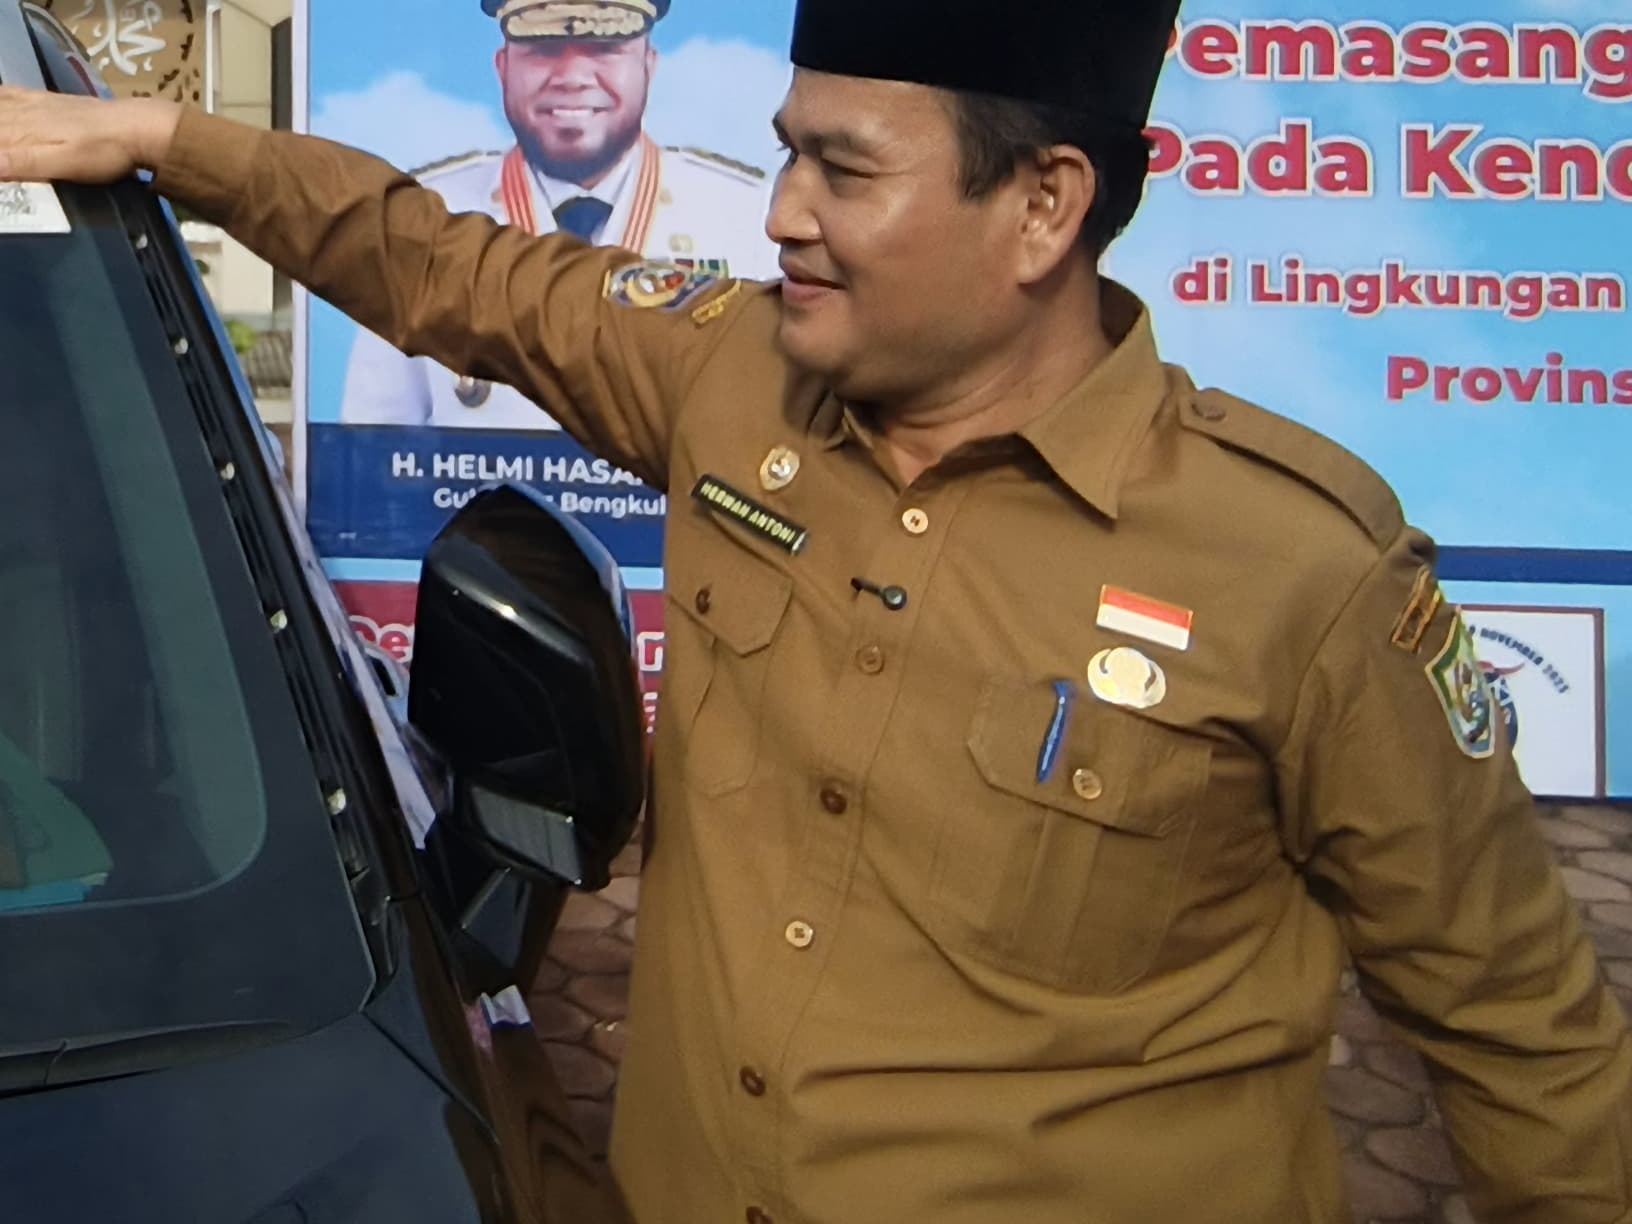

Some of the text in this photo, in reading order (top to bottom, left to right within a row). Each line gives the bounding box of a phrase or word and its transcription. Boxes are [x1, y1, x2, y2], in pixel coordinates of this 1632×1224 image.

[1166, 19, 1632, 103] emasang
[1172, 255, 1624, 318] di Lingkungan
[1387, 352, 1632, 405] Provins
[392, 452, 643, 486] H. HELMI HASA
[748, 510, 795, 544] ANTONI
